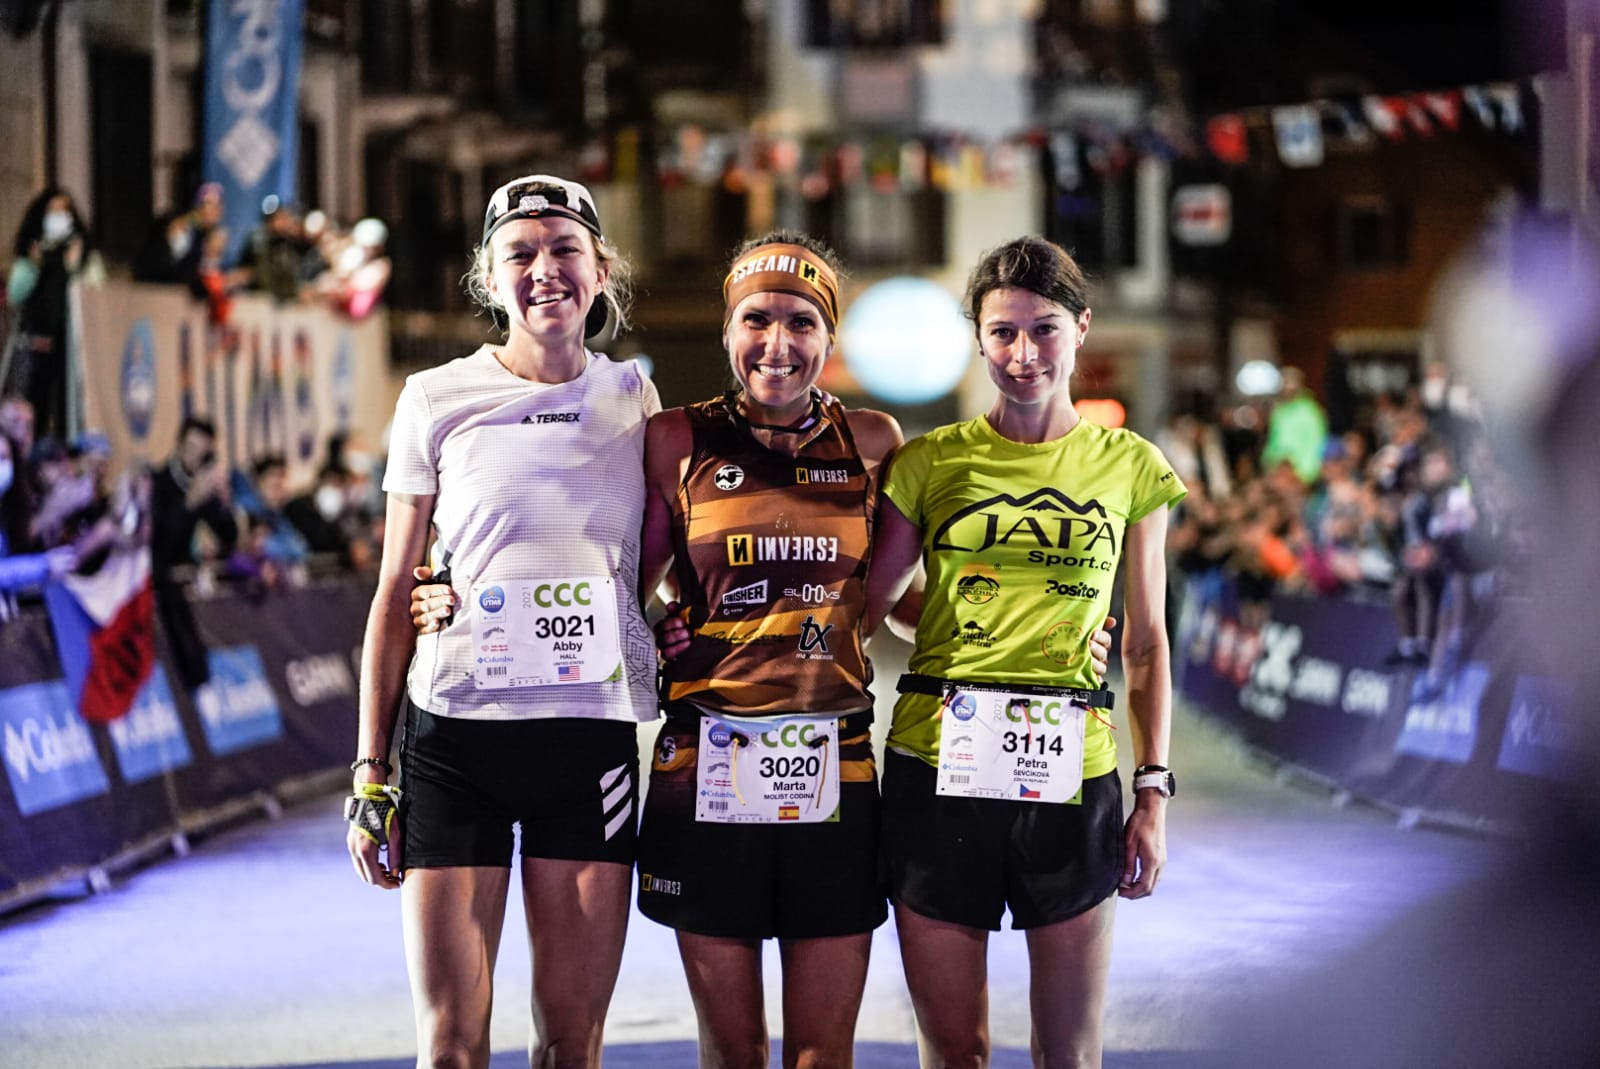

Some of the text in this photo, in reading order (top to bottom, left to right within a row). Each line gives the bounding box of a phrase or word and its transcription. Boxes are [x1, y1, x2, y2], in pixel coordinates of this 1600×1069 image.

[536, 413, 581, 424] TERREX
[976, 512, 1116, 556] JAPA
[1028, 550, 1112, 571] Sport.cz
[533, 582, 592, 608] CCC
[535, 614, 595, 639] 3021
[552, 641, 583, 652] Abby
[1005, 697, 1061, 726] CCC
[761, 724, 816, 748] CCC
[1002, 731, 1064, 756] 3114
[759, 756, 820, 778] 3020
[1017, 757, 1048, 769] Petra
[773, 781, 806, 791] Marta
